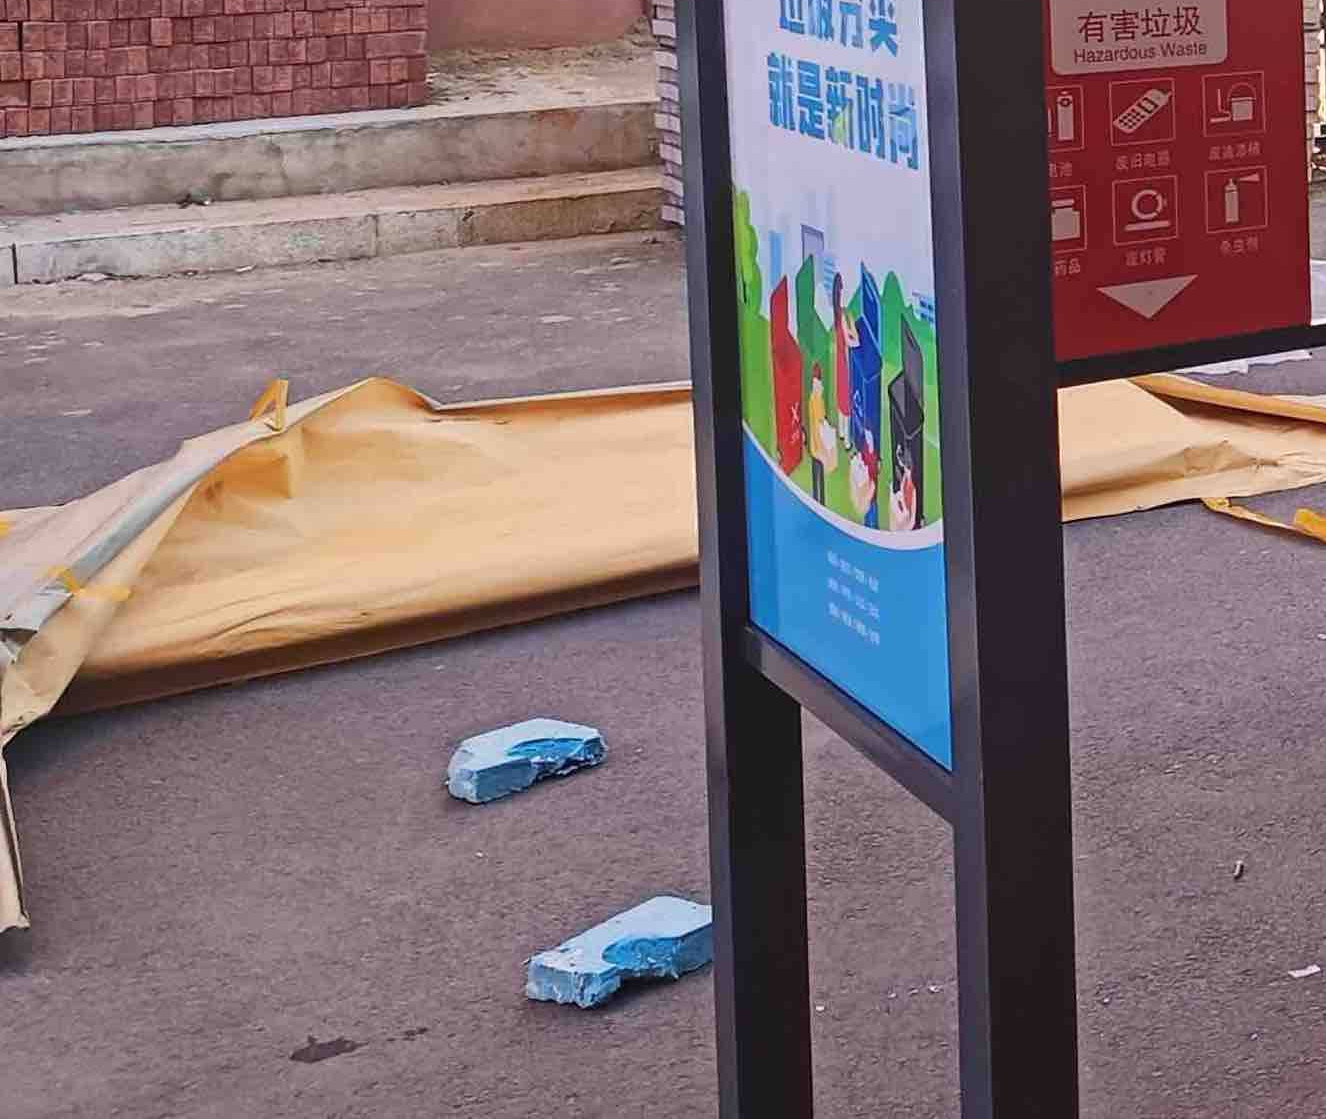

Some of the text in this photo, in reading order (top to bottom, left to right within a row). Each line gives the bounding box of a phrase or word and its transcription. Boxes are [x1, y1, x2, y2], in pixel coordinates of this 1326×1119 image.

[1077, 6, 1203, 43] 有害垃圾
[1074, 42, 1208, 64] Hazardous Waste
[767, 51, 920, 171] 就是新时尚
[1054, 258, 1081, 276] 药品
